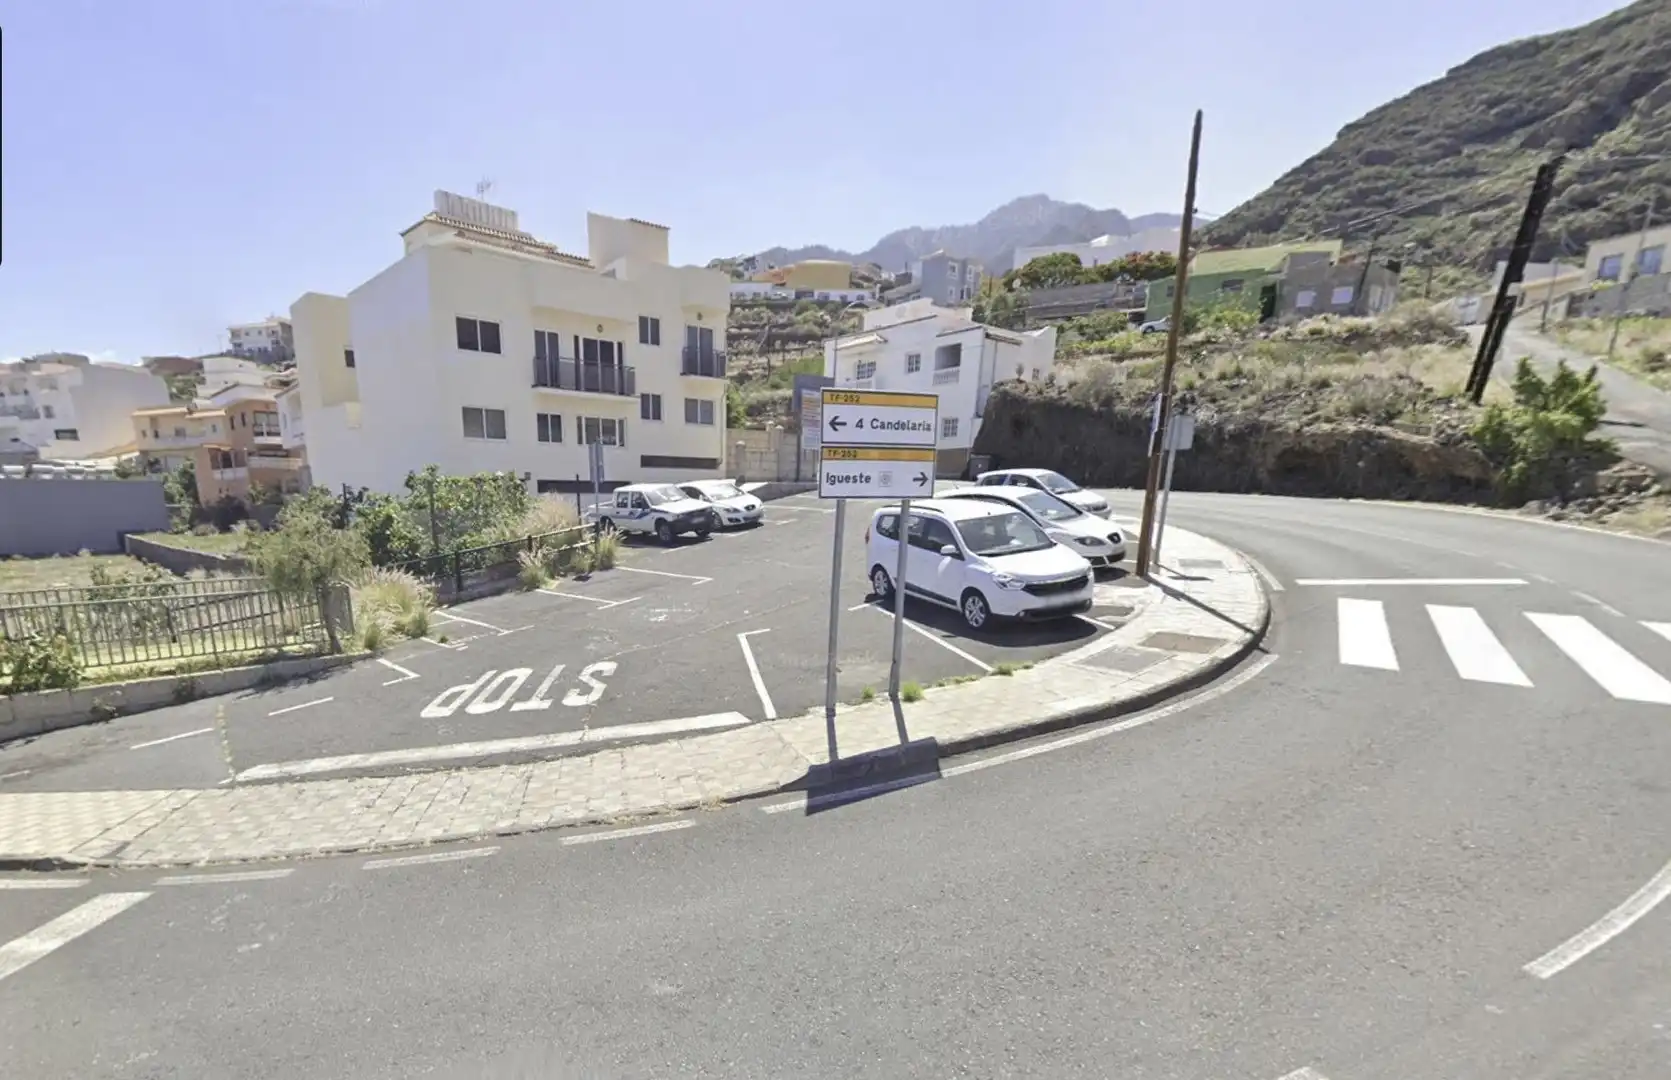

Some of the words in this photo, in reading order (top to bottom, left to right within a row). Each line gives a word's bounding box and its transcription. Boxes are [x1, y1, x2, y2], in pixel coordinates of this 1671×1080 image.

[829, 393, 861, 403] TF-252
[855, 418, 864, 430] 4
[870, 418, 932, 432] Candelaria
[825, 472, 872, 485] Igueste
[420, 661, 618, 718] STOP
